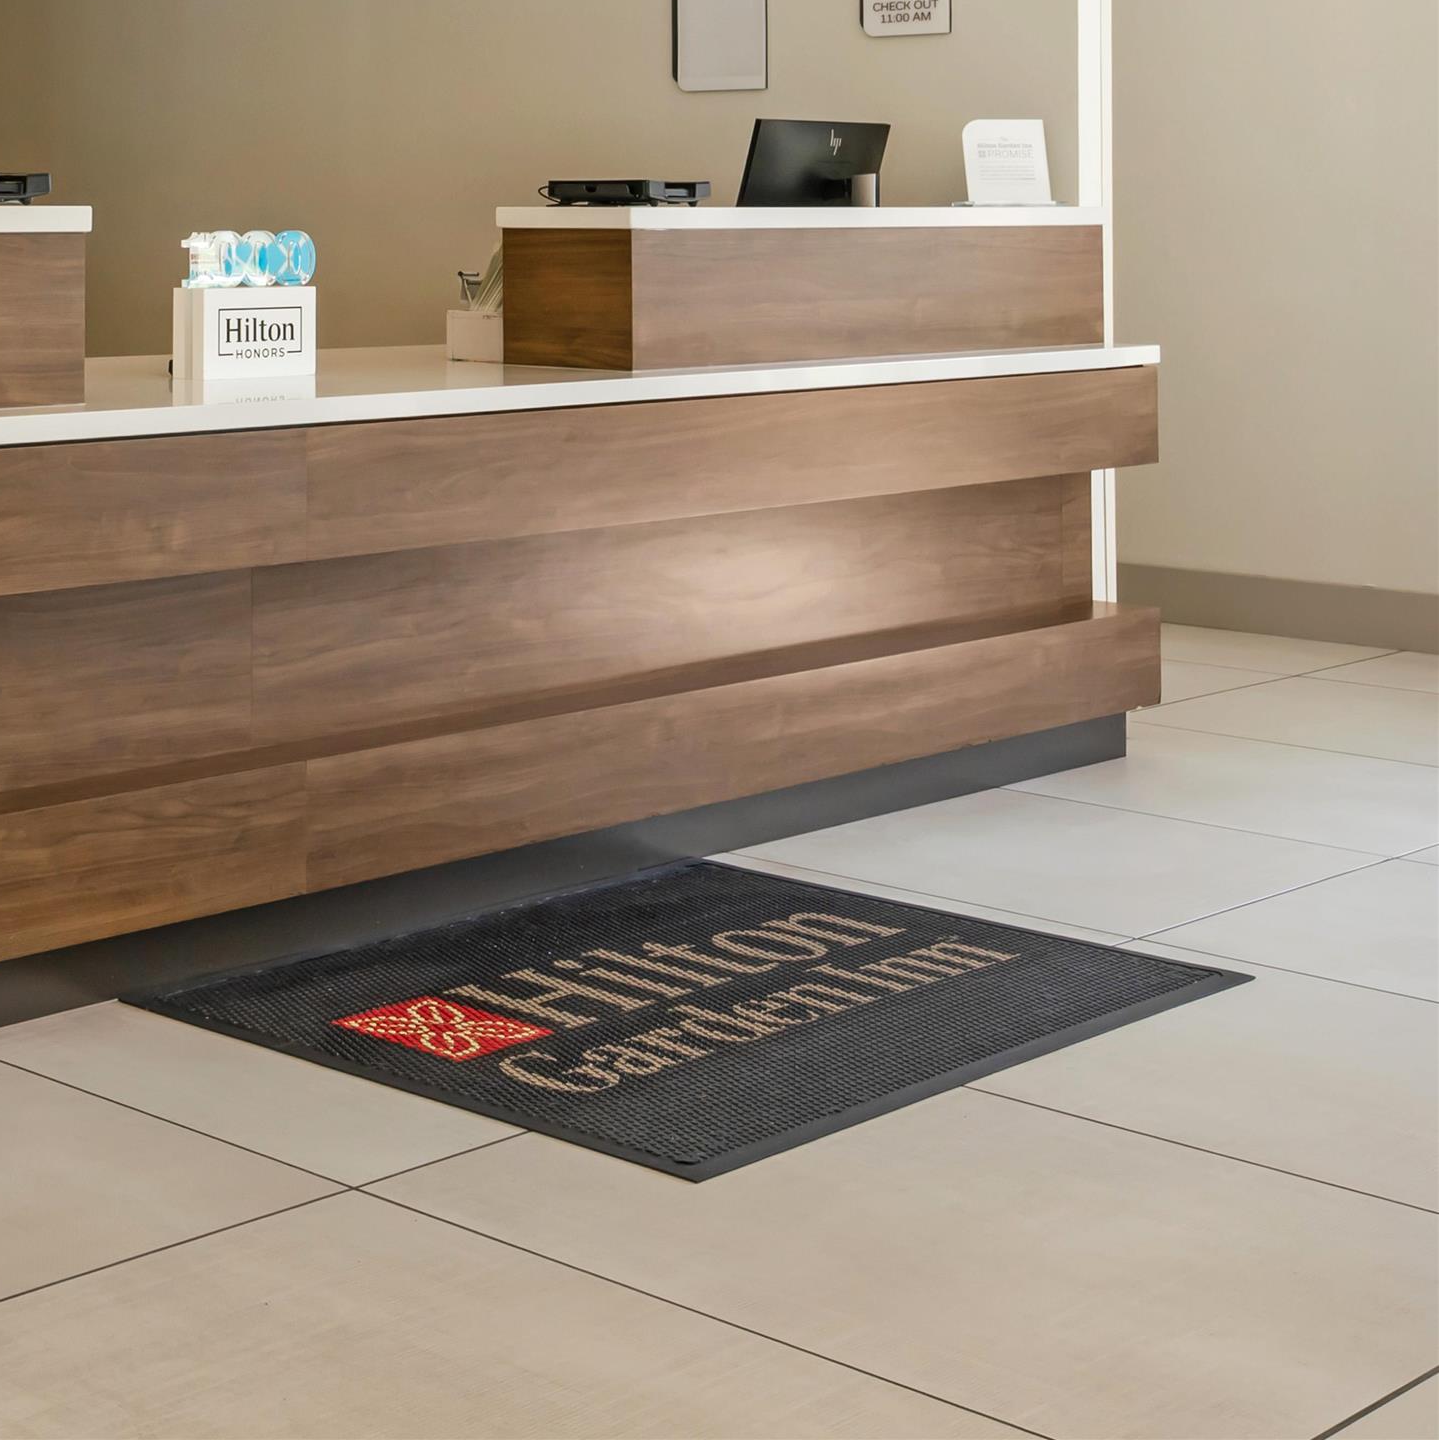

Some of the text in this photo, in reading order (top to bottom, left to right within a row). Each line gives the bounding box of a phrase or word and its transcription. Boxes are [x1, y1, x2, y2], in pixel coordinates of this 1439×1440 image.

[872, 0, 912, 13] CHECK
[880, 11, 932, 24] 11:00 AM
[225, 317, 295, 344] Hilton
[235, 347, 286, 360] HONORS
[443, 911, 906, 1030] Hilton
[497, 938, 1021, 1093] Garden Inn
